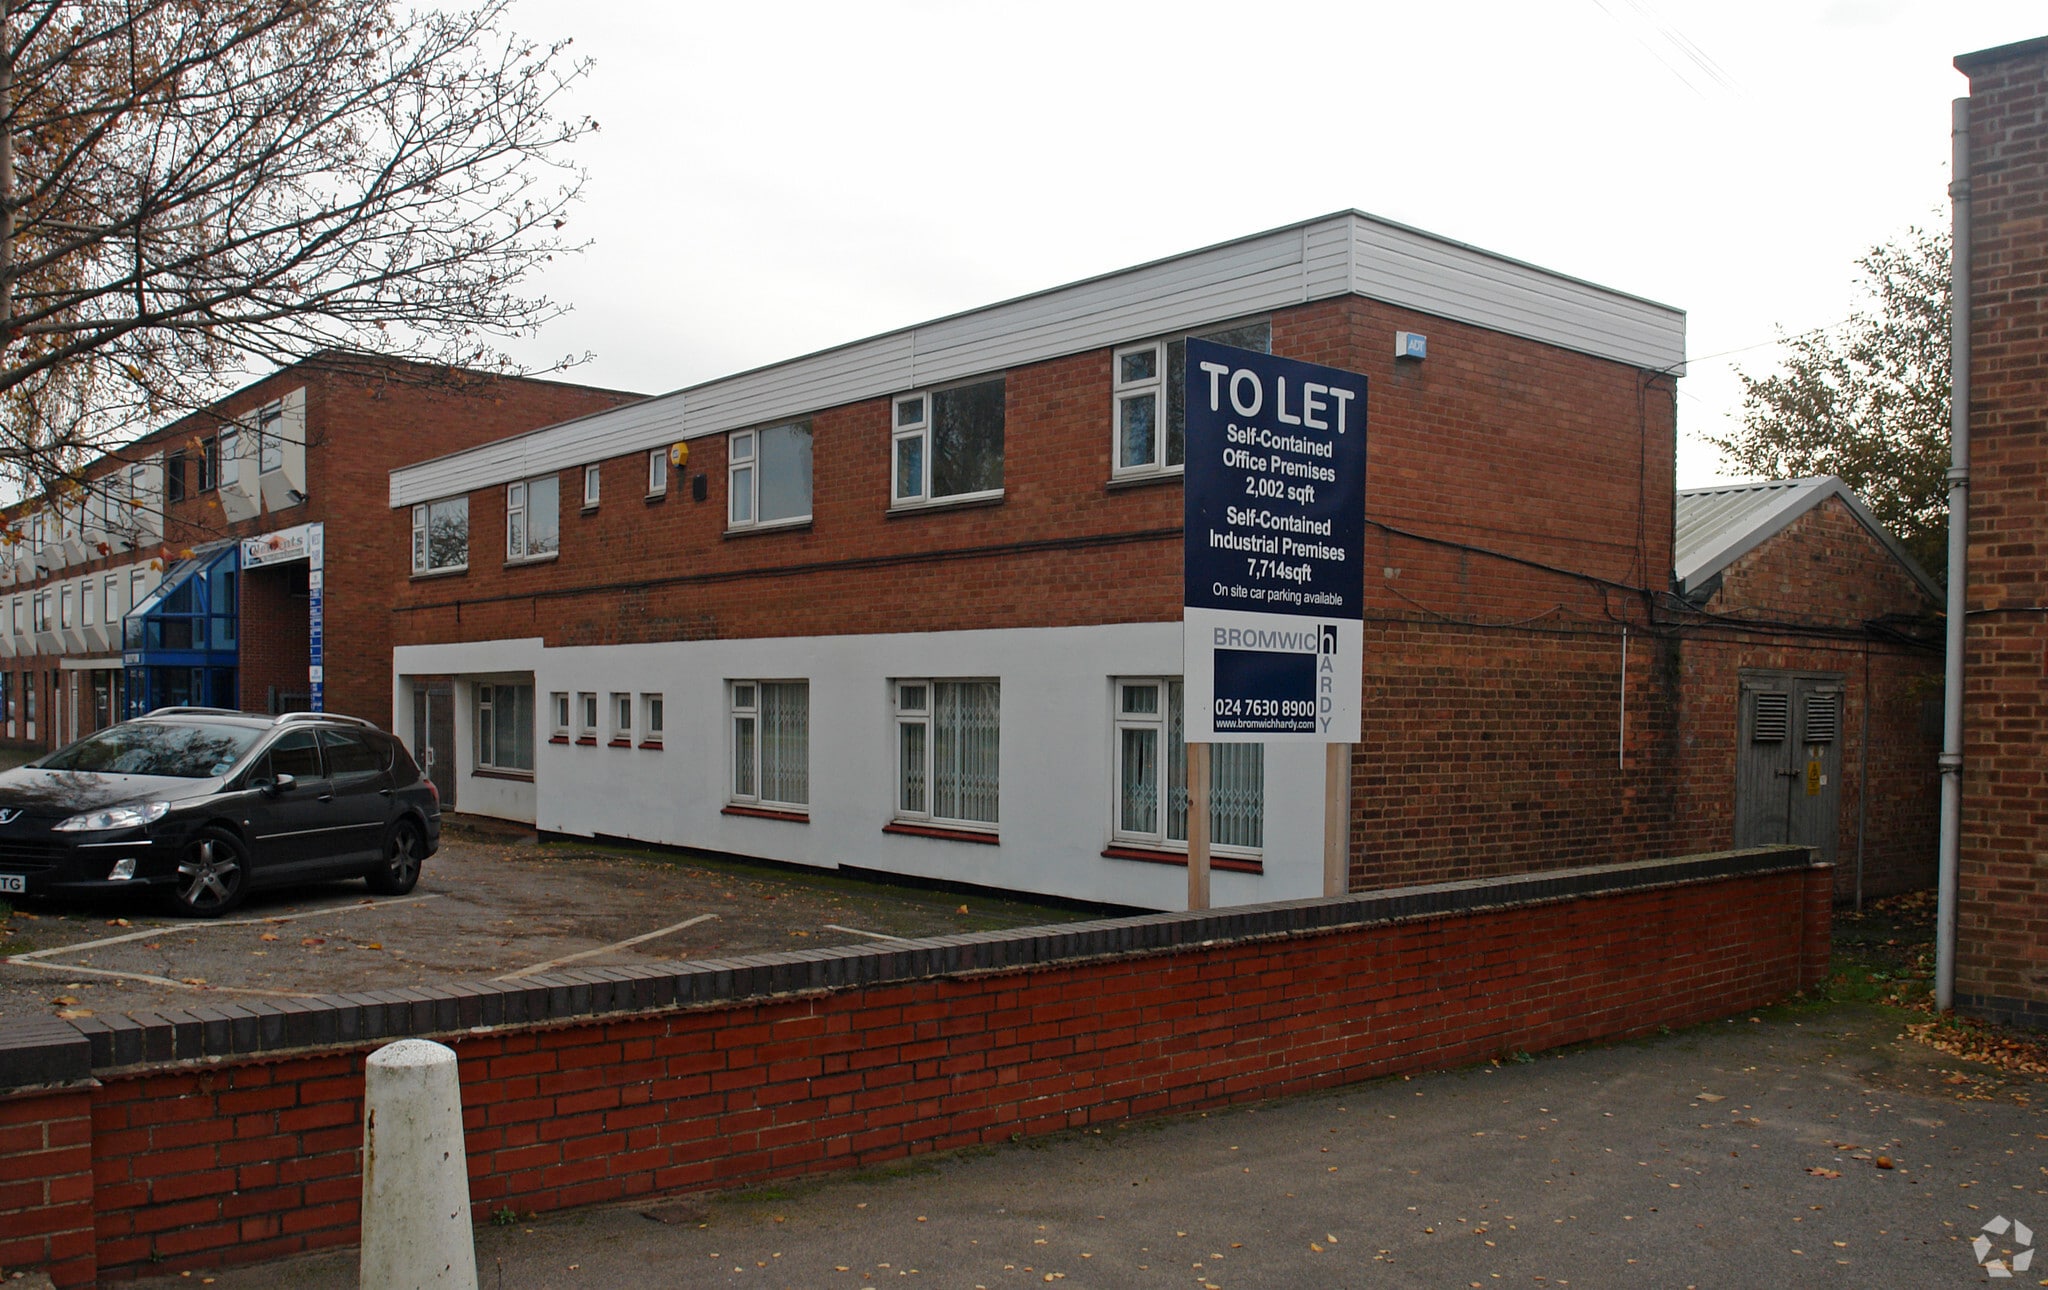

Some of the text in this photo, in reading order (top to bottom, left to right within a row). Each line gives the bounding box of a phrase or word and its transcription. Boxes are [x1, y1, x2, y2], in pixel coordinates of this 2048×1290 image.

[1200, 361, 1355, 434] TO LET
[1227, 423, 1333, 458] Self-Contained
[1223, 448, 1335, 482] Office Premises
[1246, 476, 1315, 506] 2,002 sqft
[1226, 506, 1331, 536] Self-Contained
[1210, 529, 1345, 561] Industrial Premises
[1213, 582, 1343, 606] On site car parking available
[1215, 699, 1315, 717] 024 7630 8900
[1215, 718, 1315, 731] www.bromwichhardy.com
